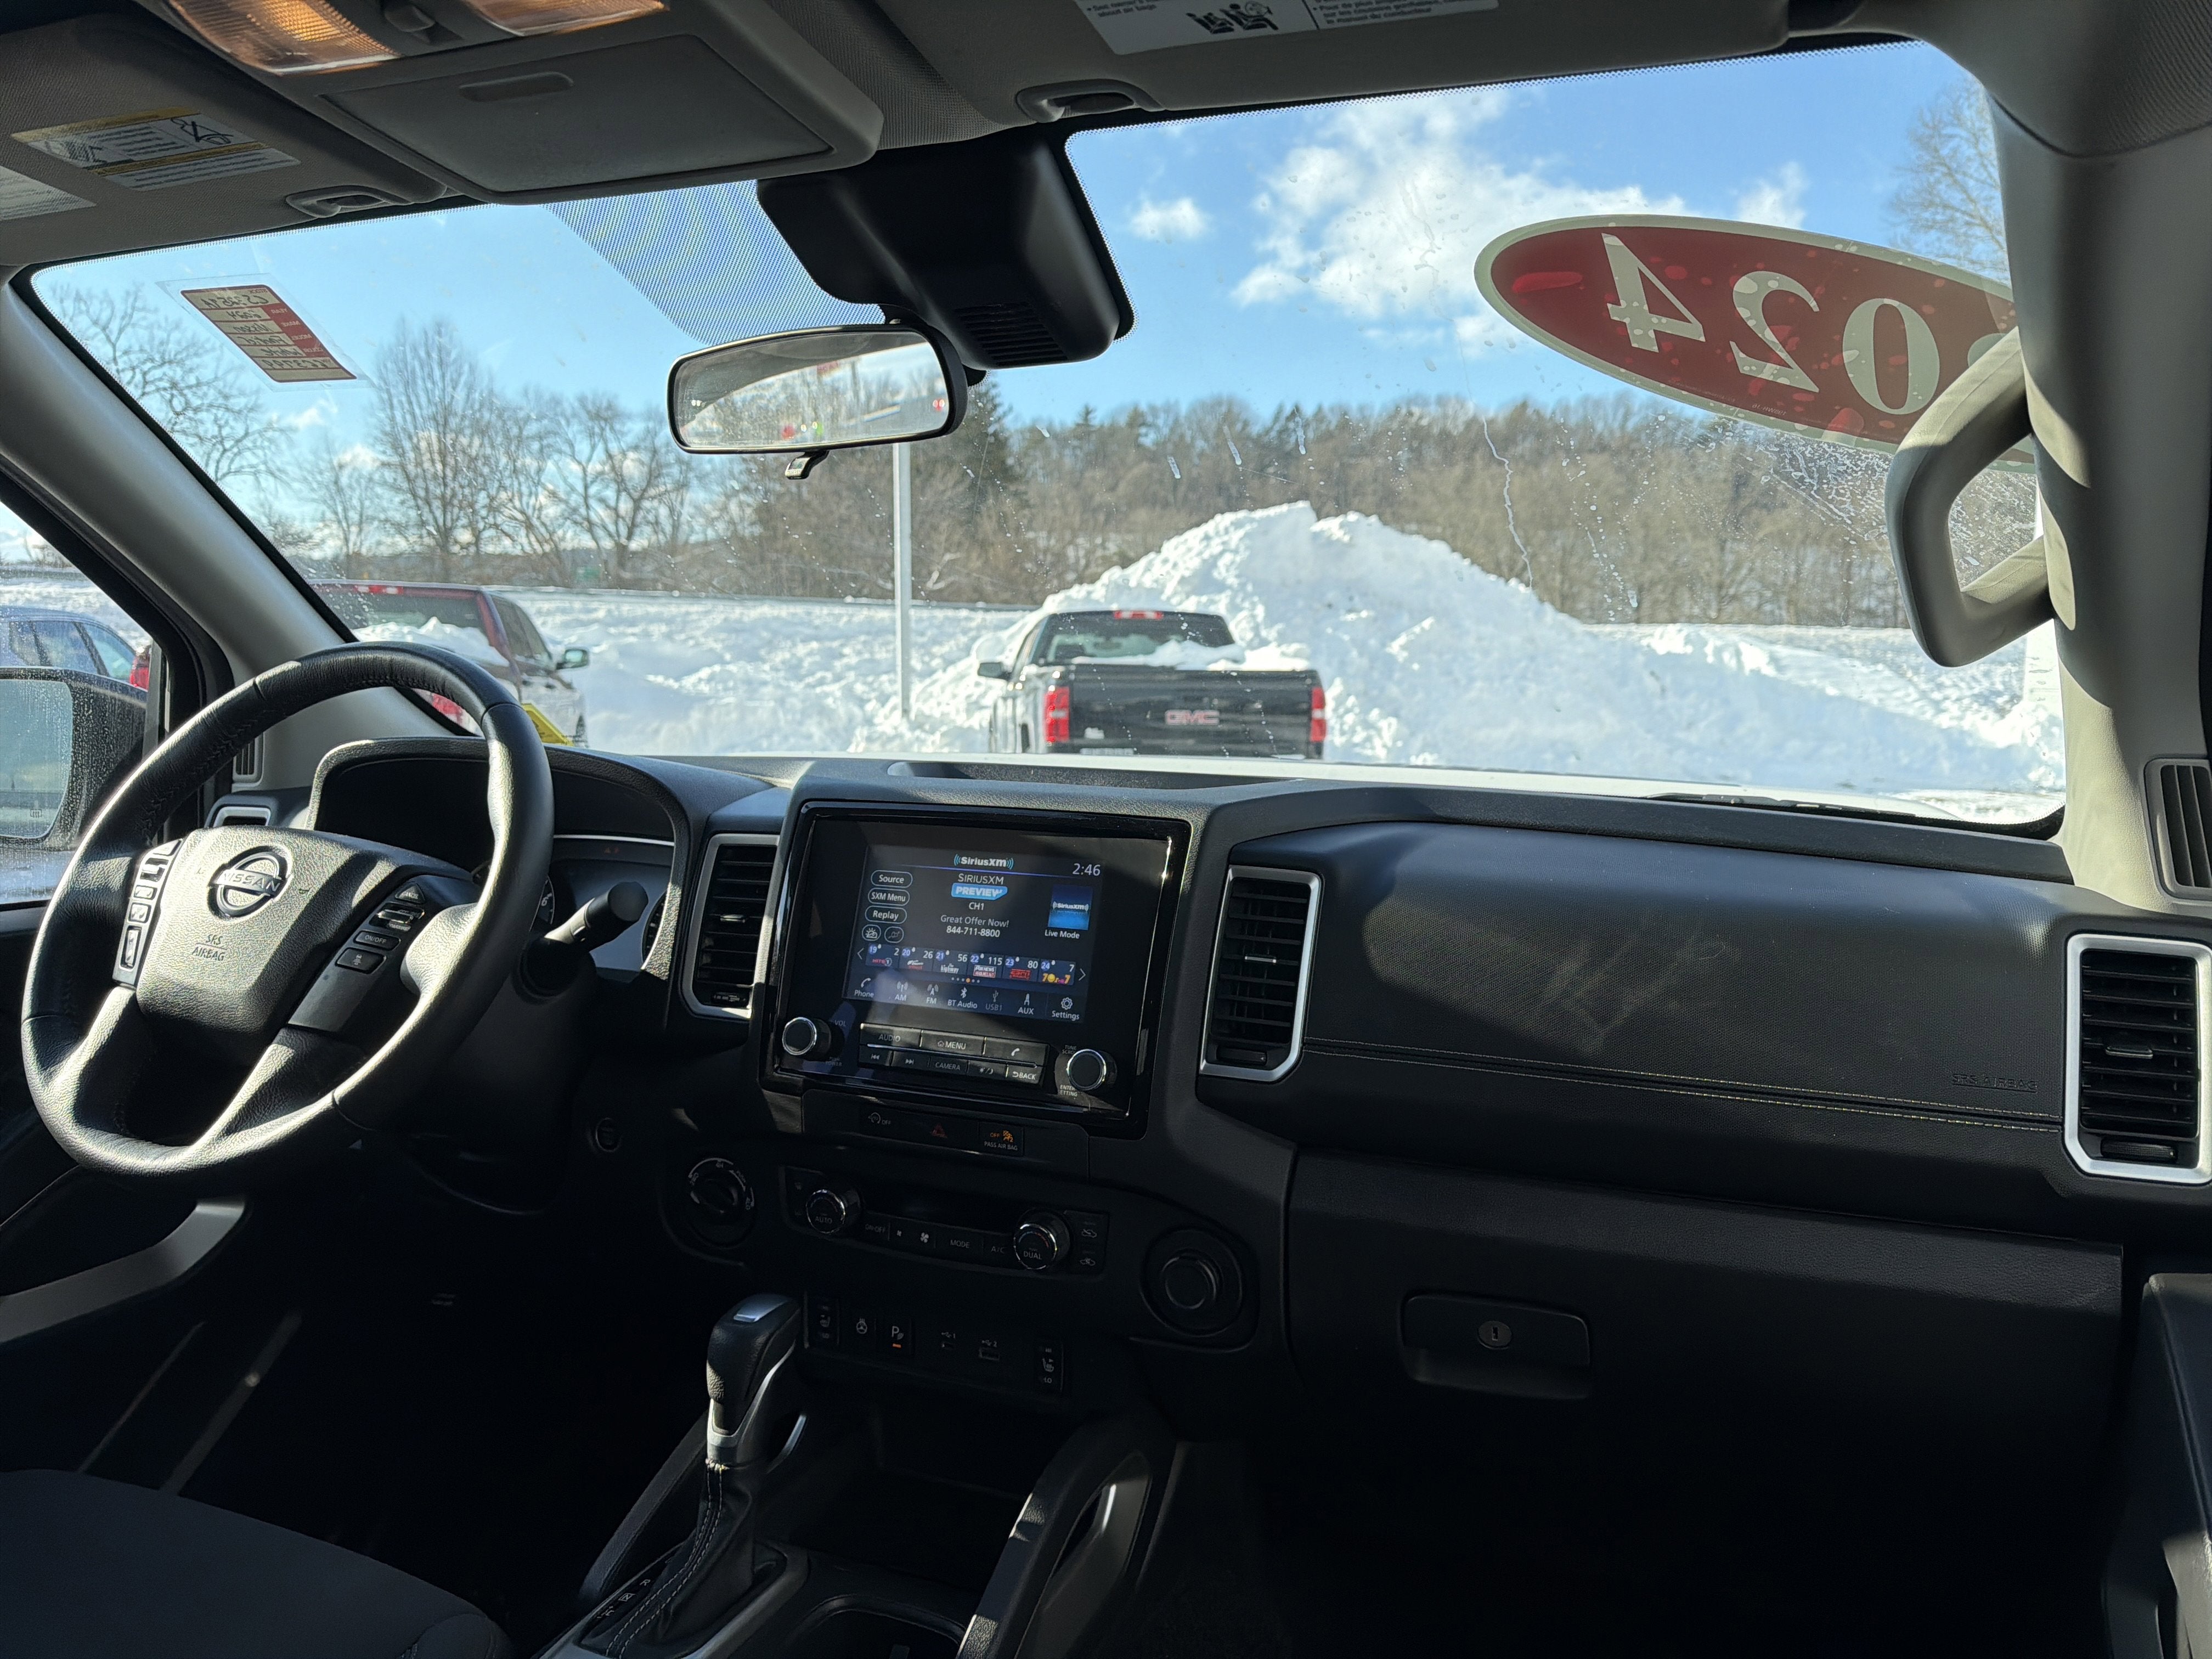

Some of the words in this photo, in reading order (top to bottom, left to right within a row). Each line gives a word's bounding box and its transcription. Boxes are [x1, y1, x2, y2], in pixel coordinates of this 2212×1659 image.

[1165, 709, 1220, 725] GMC
[1073, 863, 1101, 876] 2:46
[223, 872, 281, 892] NISSAN
[878, 874, 904, 884] Source
[958, 873, 1004, 884] SIRIUSXM
[871, 892, 886, 900] SXM
[887, 893, 906, 902] Menu
[956, 887, 1003, 898] PREVIEW
[969, 902, 984, 911] CH1
[873, 910, 899, 921] Replay
[941, 915, 962, 924] Great
[964, 917, 985, 926] Offer
[988, 918, 1009, 928] Now!
[946, 926, 1000, 938] 844-711-8800
[1059, 931, 1080, 939] Mode
[365, 935, 386, 944] ON/OFF
[191, 946, 225, 961] AIRBAG
[988, 957, 1002, 966] 115
[1028, 961, 1038, 969] 80
[1041, 962, 1050, 970] 24
[854, 990, 874, 998] Phone
[1052, 1011, 1080, 1021] Settings
[878, 1034, 900, 1042] AUDIO
[945, 1042, 966, 1050] MENU
[935, 1062, 960, 1070] CAMERA
[1019, 1072, 1036, 1080] BACK
[815, 1216, 833, 1224] AUTO
[950, 1239, 970, 1249] MODE
[1023, 1250, 1042, 1260] DUAL
